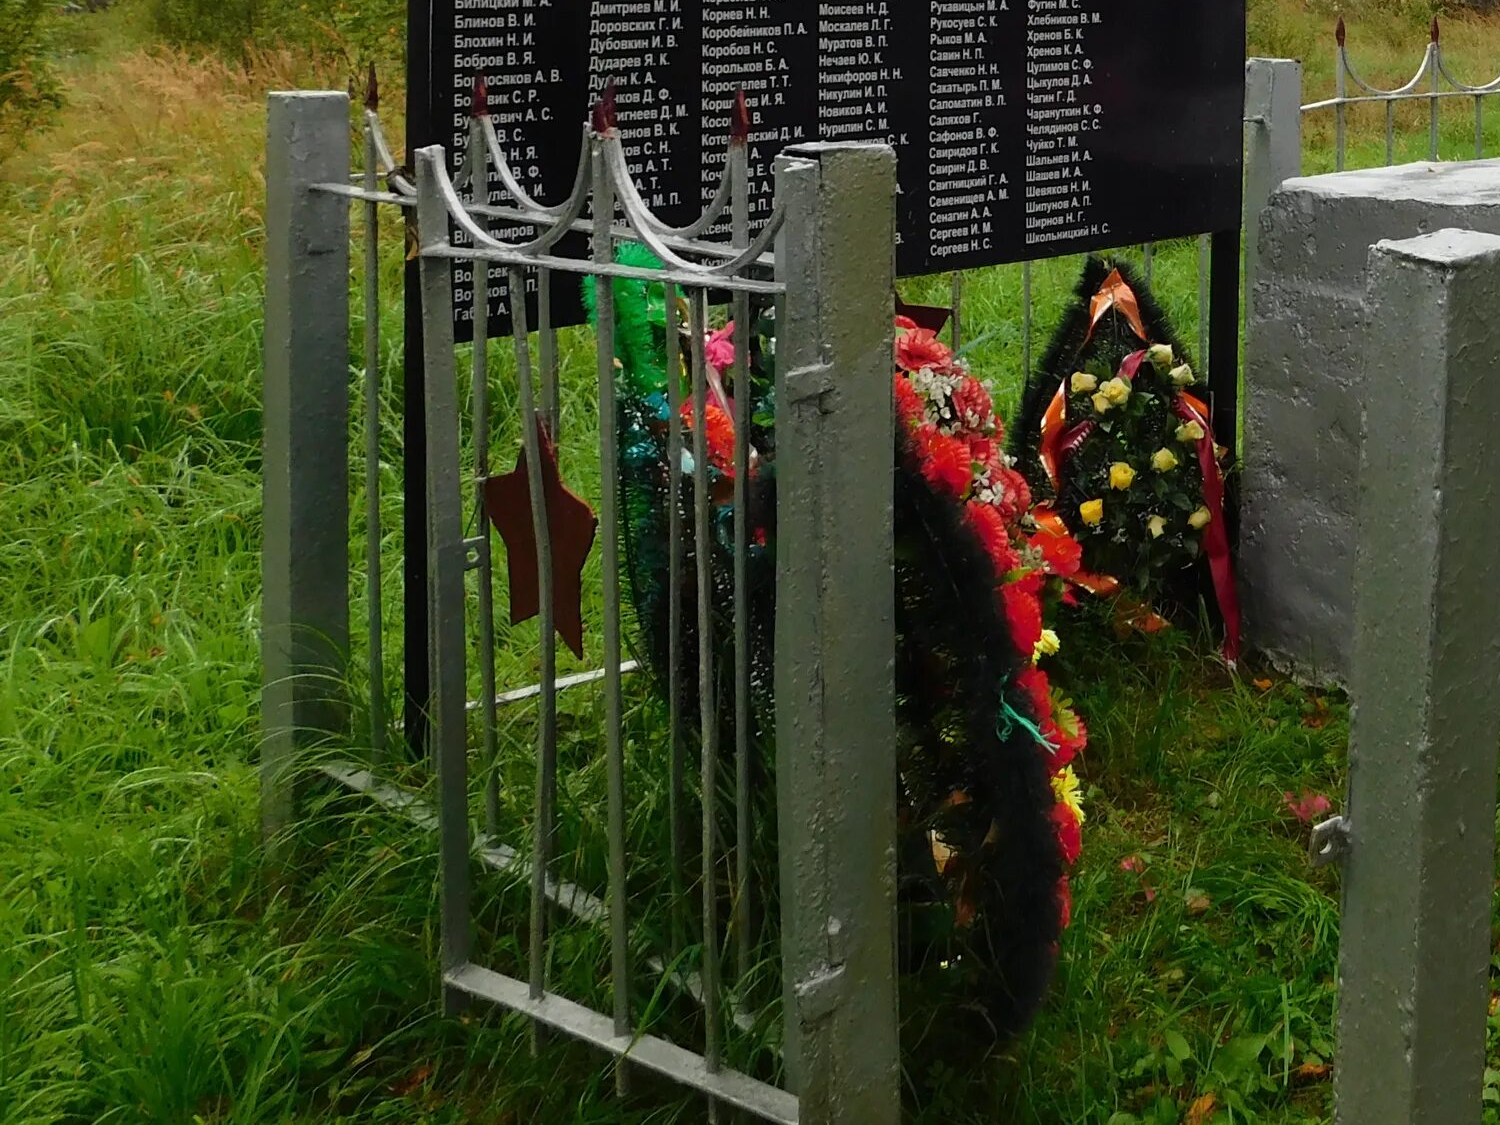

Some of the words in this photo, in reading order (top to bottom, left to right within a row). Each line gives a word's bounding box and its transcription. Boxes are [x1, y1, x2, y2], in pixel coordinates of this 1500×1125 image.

[590, 1, 650, 16] Дмитриев
[819, 3, 863, 15] Моисеев
[930, 0, 985, 15] Рукавицын
[454, 14, 504, 28] Блинов
[702, 8, 743, 23] Корнев
[1027, 13, 1078, 25] Хлебников
[589, 19, 655, 35] Доровских
[818, 20, 869, 32] Москалев
[930, 17, 975, 31] Рукосуев
[702, 25, 781, 41] Коробейников
[930, 33, 962, 44] Рыков
[1026, 29, 1062, 43] Хренов
[454, 34, 503, 48] Блохин
[589, 37, 648, 54] Дубовкин
[818, 37, 863, 52] Муратов
[702, 42, 750, 59] Коробов
[929, 49, 960, 61] Савин
[1026, 45, 1062, 59] Хренов
[454, 53, 503, 69] Бобров
[507, 52, 519, 65] В.
[522, 51, 535, 64] Я.
[588, 56, 641, 72] Дударев
[644, 53, 656, 66] Я.
[659, 52, 669, 65] К.
[818, 54, 855, 66] Нечаев
[701, 62, 762, 77] Корольков
[929, 65, 975, 77] Савченко
[818, 70, 877, 85] Никифоров
[1026, 77, 1069, 90] Цыкулов
[818, 88, 862, 102] Никулин
[1026, 92, 1054, 103] Чагин
[818, 105, 862, 117] Новиков
[929, 98, 983, 110] Саломатин
[929, 114, 971, 126] Саляхов
[929, 130, 973, 144] Сафонов
[929, 146, 977, 160] Свиридов
[1026, 139, 1055, 153] Чуйко
[1026, 154, 1069, 166] Шальнев
[928, 163, 966, 176] Свирин
[1025, 170, 1060, 182] Шашев
[928, 177, 986, 191] Свитницкий
[1025, 185, 1068, 197] Шевяков
[929, 193, 984, 207] Семенищев
[1025, 200, 1069, 213] Шипунов
[929, 211, 968, 223] Сенагин
[1025, 216, 1063, 229] Ширнов
[929, 227, 968, 241] Сергеев
[1025, 225, 1088, 244] Школьницкий
[930, 243, 969, 257] Сергеев
